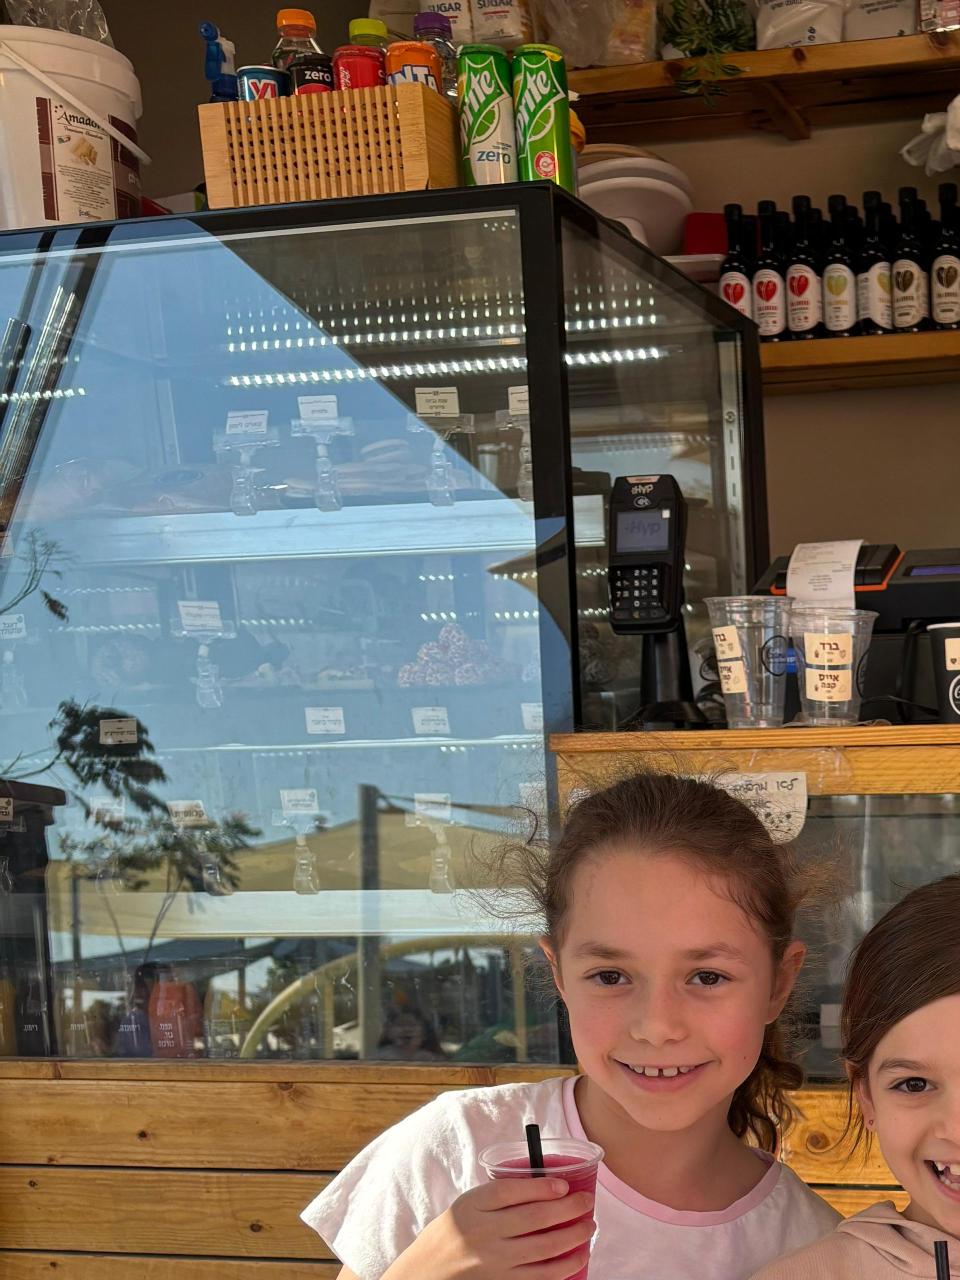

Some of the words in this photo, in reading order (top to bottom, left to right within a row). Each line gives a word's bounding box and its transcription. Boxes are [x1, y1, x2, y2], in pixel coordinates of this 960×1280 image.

[304, 70, 333, 83] zero
[460, 69, 496, 151] prite
[516, 69, 552, 151] prite
[476, 150, 511, 164] zero
[819, 642, 840, 651] ברד
[818, 673, 840, 682] אייס
